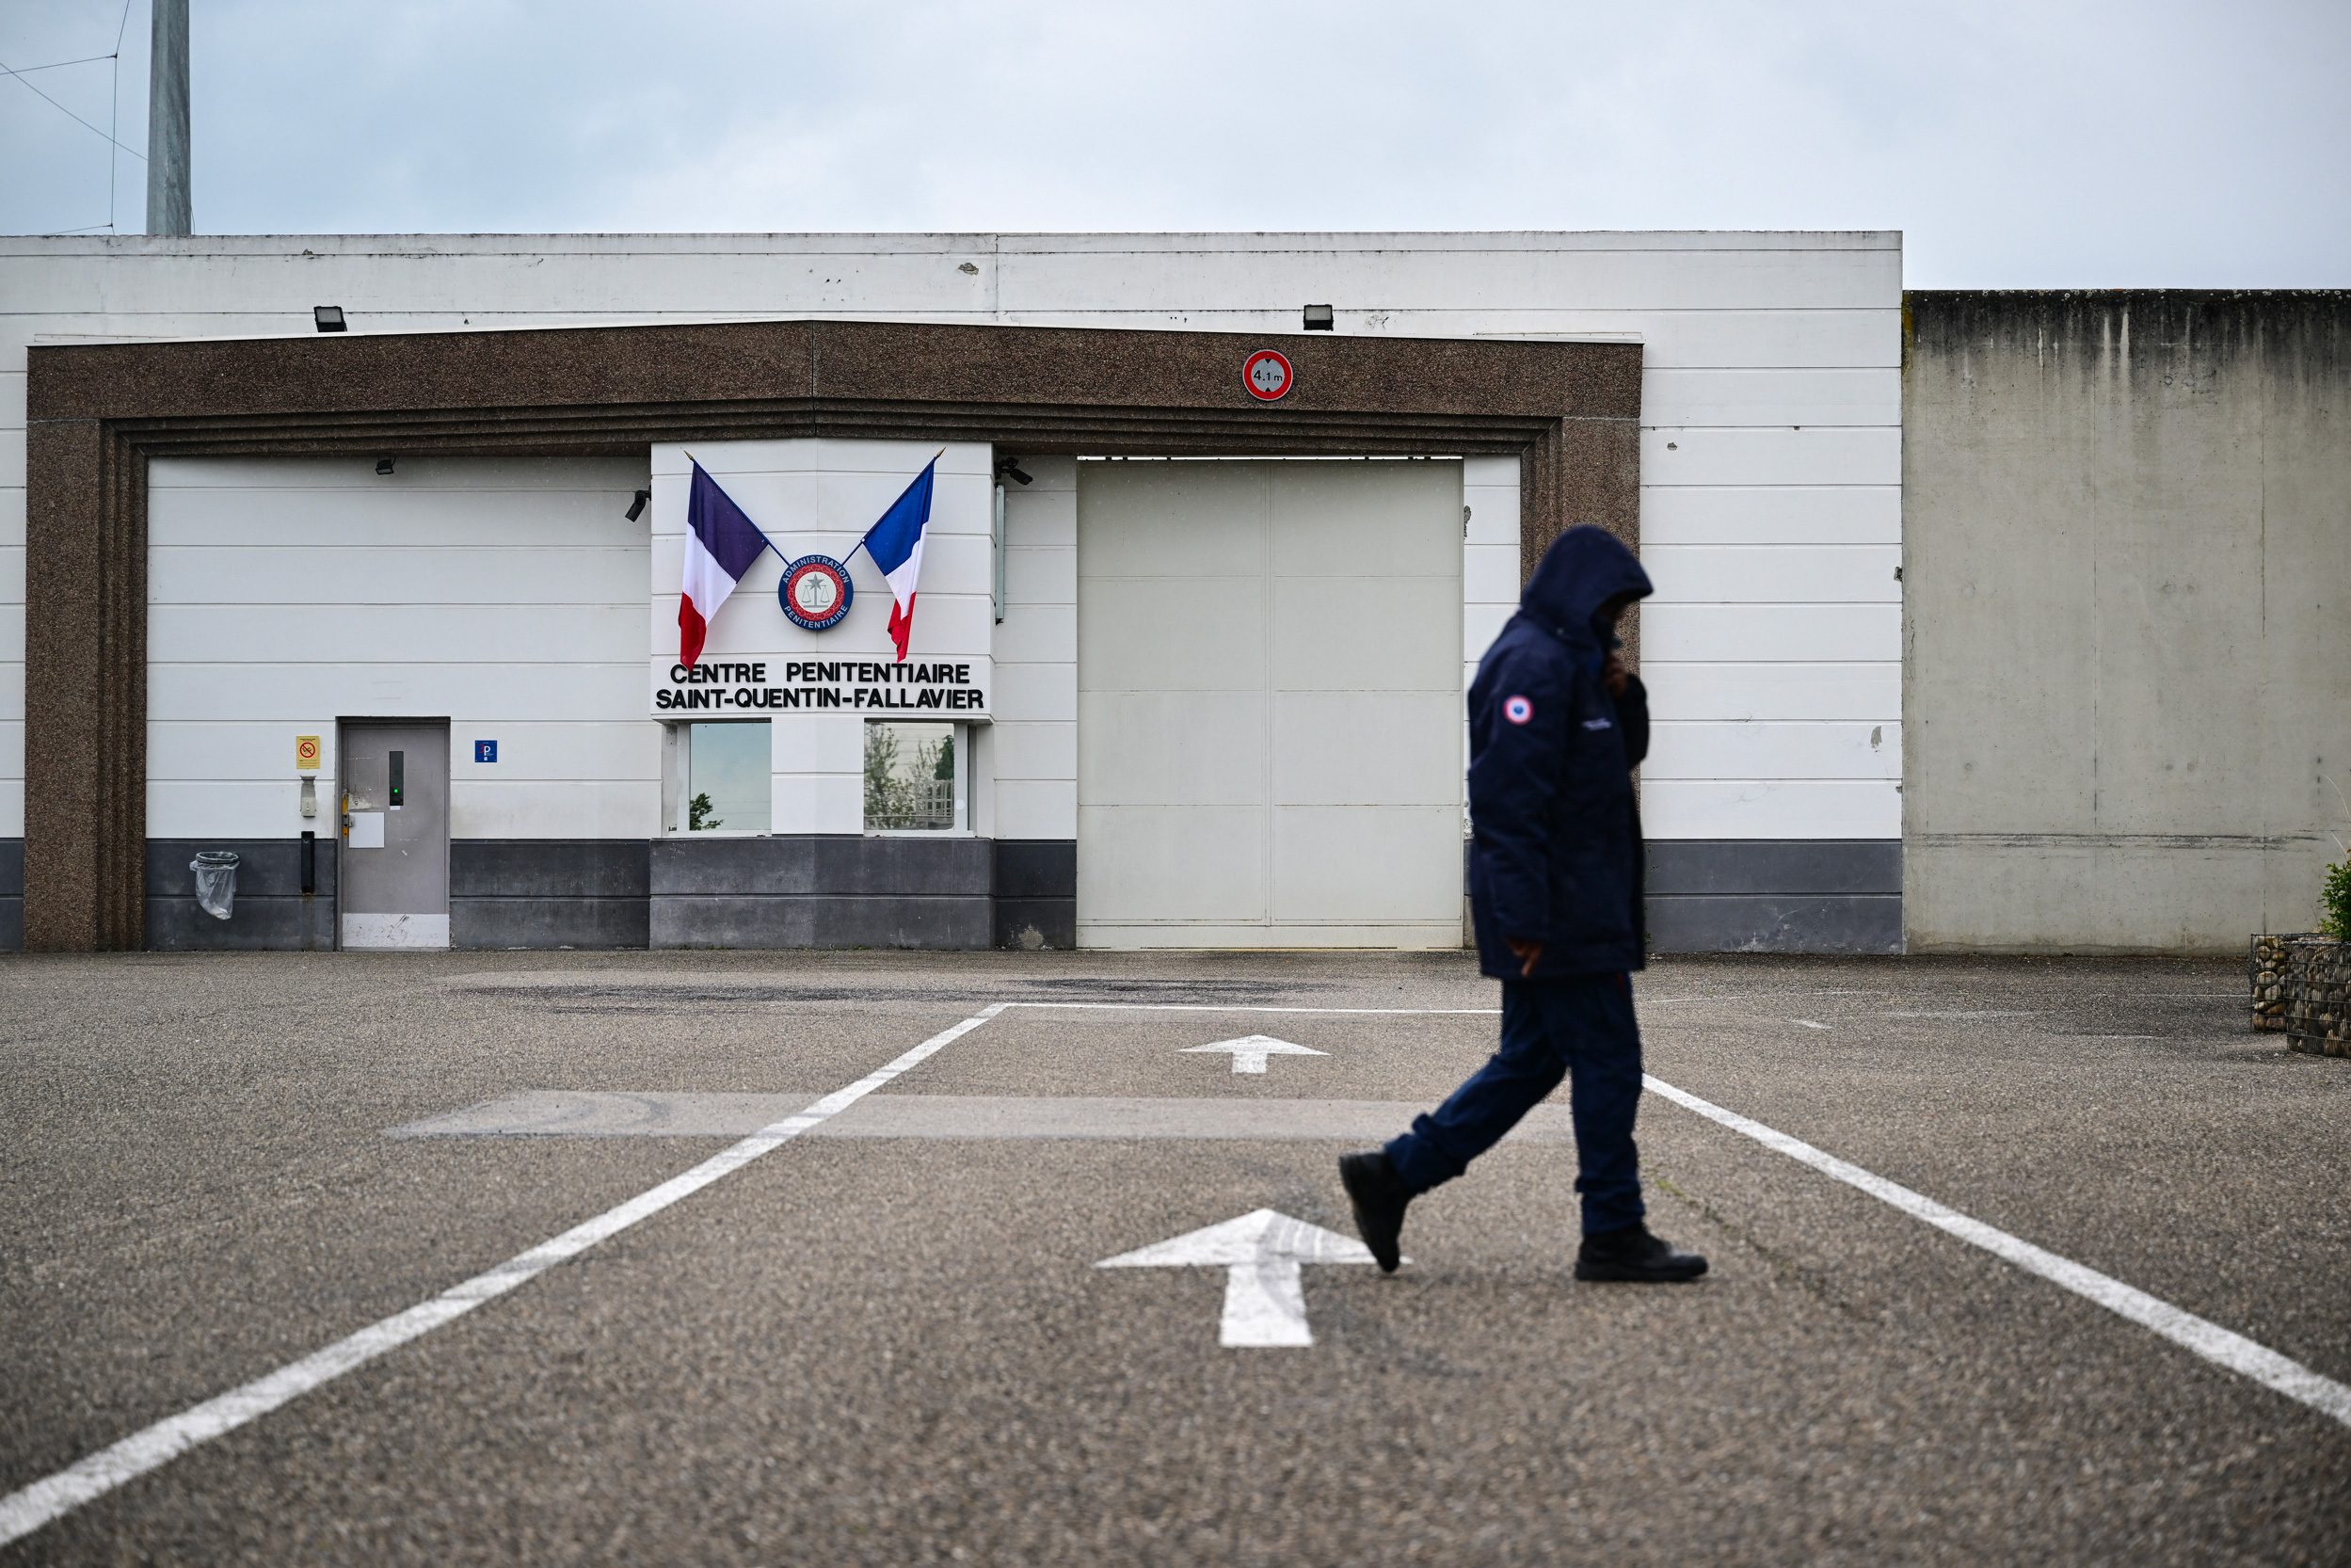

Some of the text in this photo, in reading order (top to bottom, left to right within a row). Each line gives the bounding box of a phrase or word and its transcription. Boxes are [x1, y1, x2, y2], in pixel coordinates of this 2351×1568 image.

[1254, 370, 1271, 381] 4.1
[782, 555, 850, 584] ADMINISTRATION
[784, 605, 848, 629] PENITENTIAIRE
[670, 662, 970, 683] CENTRE PENITENTIAIRE
[656, 688, 984, 709] SAINT-QUENTIN-FALLAVIER
